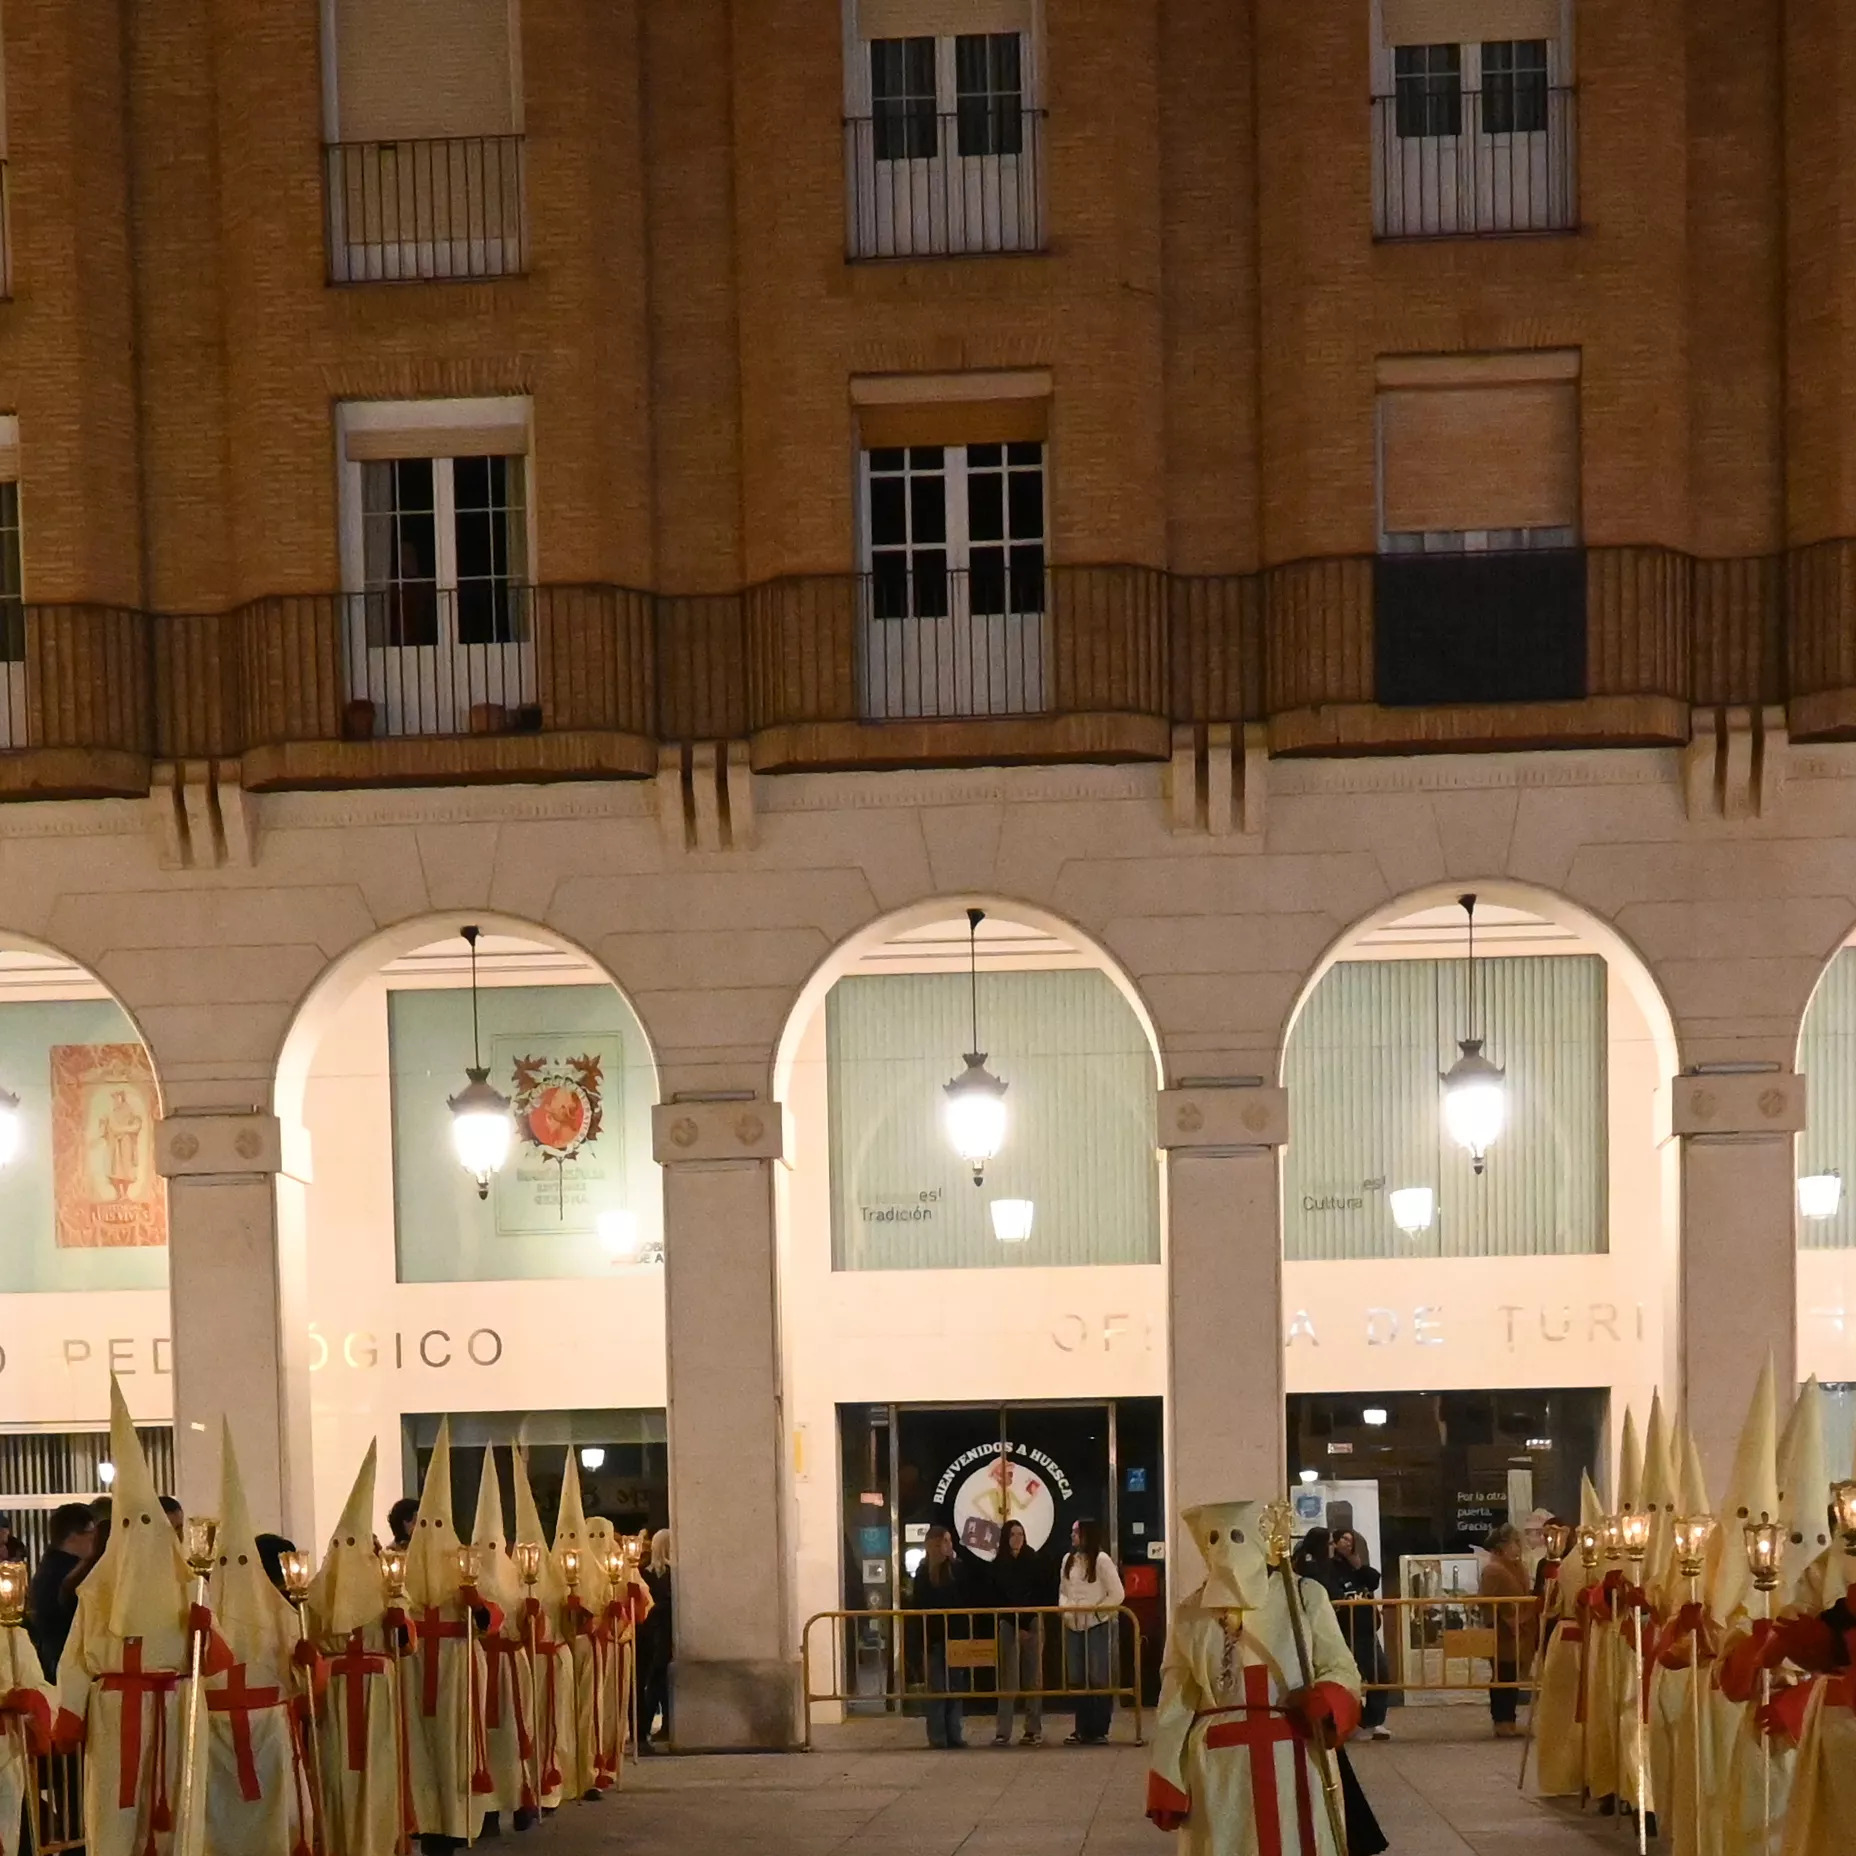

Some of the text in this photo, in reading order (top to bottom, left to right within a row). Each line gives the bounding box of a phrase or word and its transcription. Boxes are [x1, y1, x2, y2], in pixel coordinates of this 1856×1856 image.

[1302, 1195, 1363, 1211] Cultura
[860, 1204, 932, 1221] Tradición
[1497, 1302, 1644, 1346] TURI
[933, 1441, 1073, 1504] BIENVENIDOS A HUESCA
[1457, 1491, 1507, 1502] Por la otra
